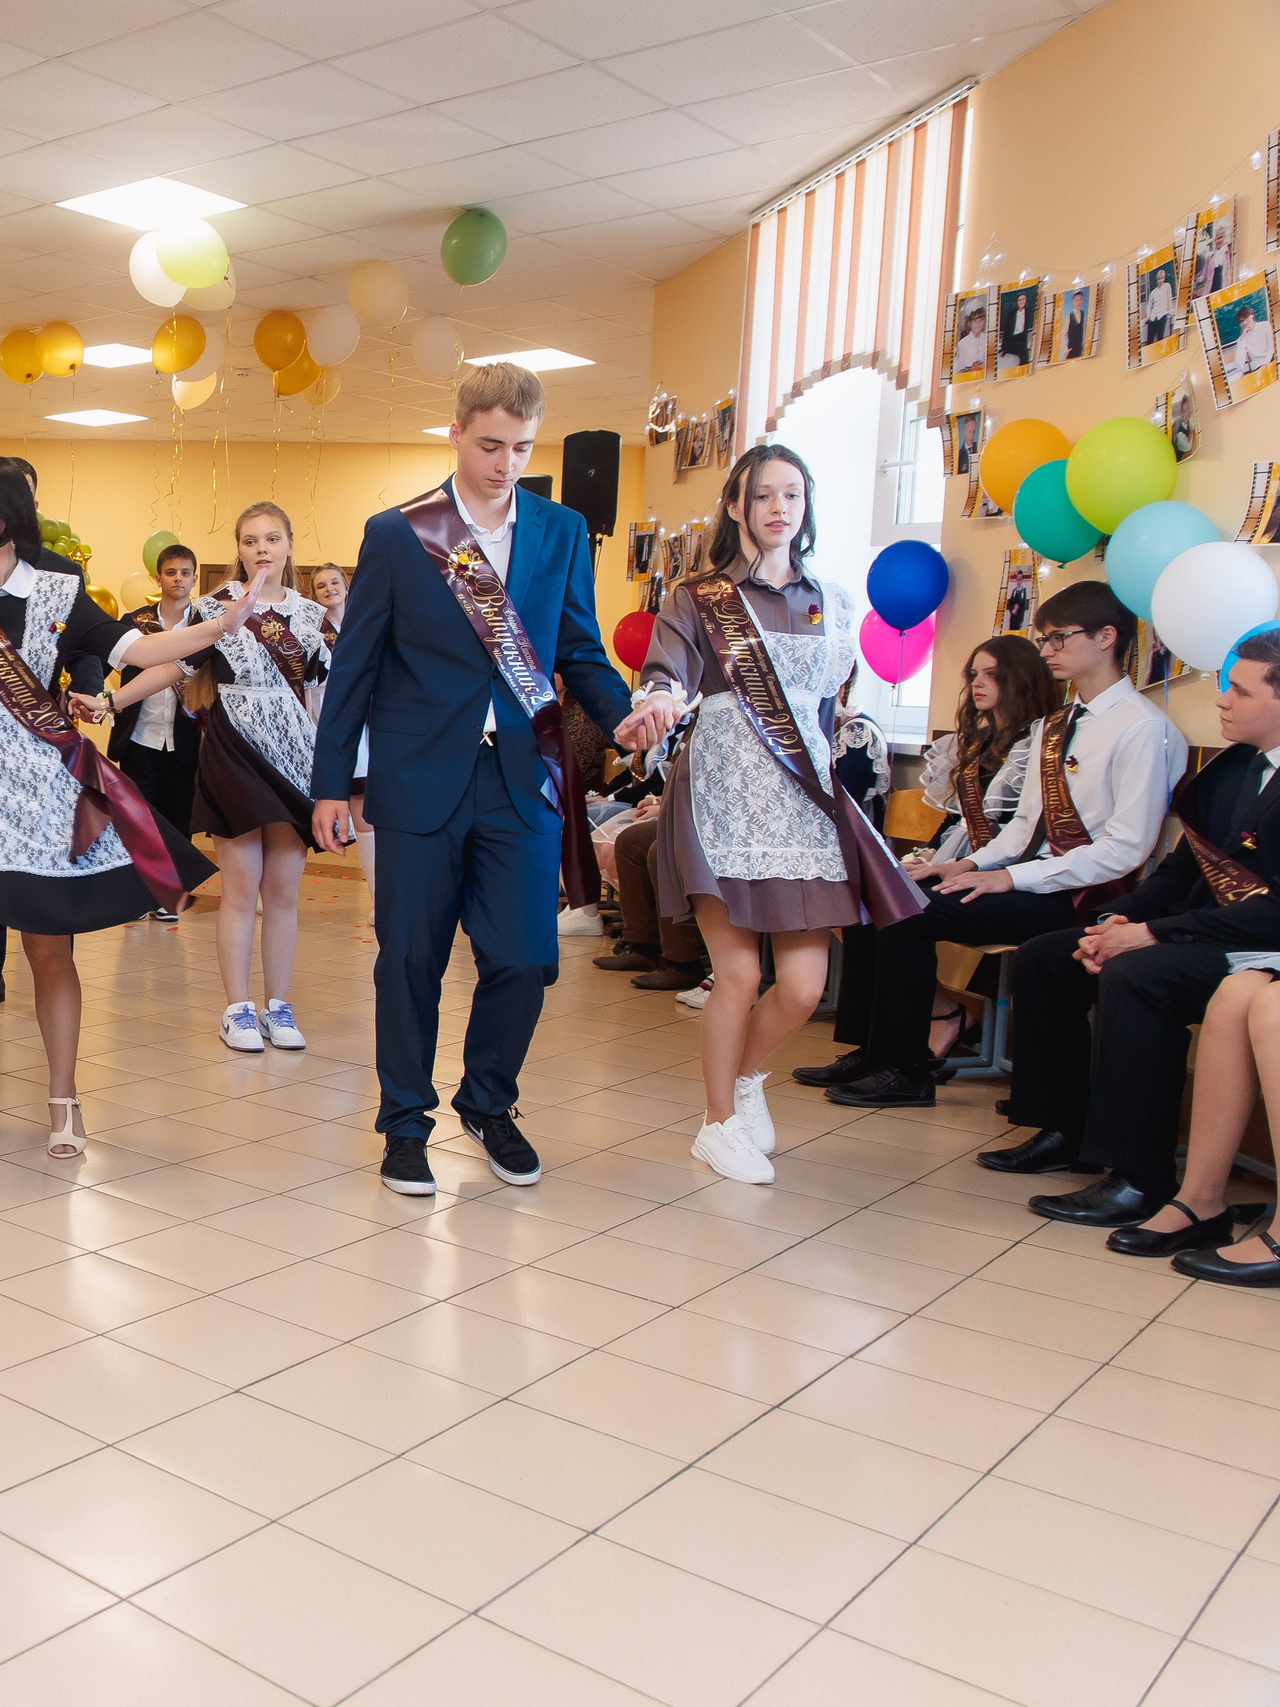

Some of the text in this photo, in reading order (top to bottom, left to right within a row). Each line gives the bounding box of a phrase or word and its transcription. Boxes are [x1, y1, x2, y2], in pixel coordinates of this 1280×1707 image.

[466, 573, 540, 695] Выпускник
[502, 606, 537, 671] Егоров Никита
[713, 599, 802, 756] Выпускница 2024
[1050, 808, 1089, 844] 2024
